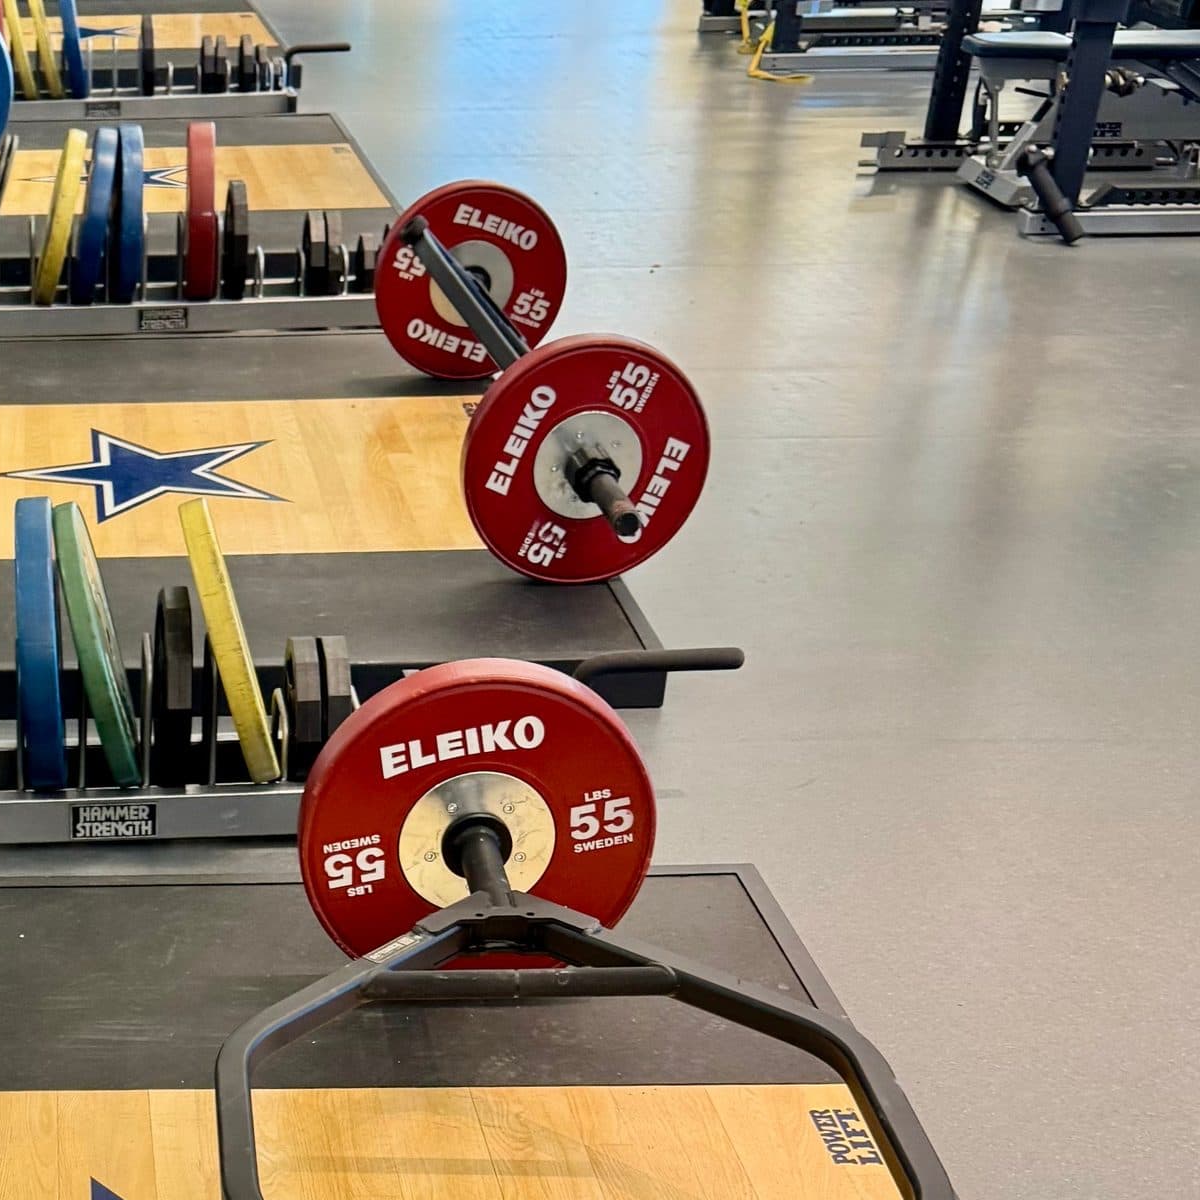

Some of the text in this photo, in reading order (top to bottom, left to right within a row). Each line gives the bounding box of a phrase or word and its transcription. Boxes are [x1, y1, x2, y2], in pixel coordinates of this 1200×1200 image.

[453, 203, 538, 251] ELEIKO
[392, 247, 426, 277] 55
[512, 292, 551, 322] 55
[406, 318, 488, 363] ELEIKO
[605, 370, 621, 390] LBS
[609, 361, 651, 410] 55
[633, 372, 660, 413] SWEDEN
[484, 385, 557, 496] ELEIKO
[527, 521, 566, 567] 55
[379, 715, 545, 780] ELEIKO
[78, 806, 150, 823] HAMMER
[584, 788, 612, 802] LBS
[76, 820, 152, 837] STRENGTH
[569, 796, 635, 840] 55
[323, 834, 381, 854] SWEDEN
[573, 832, 634, 853] SWEDEN
[323, 847, 385, 890] 55
[347, 883, 373, 897] LBS
[809, 1108, 858, 1165] POWER
[832, 1108, 883, 1165] LIFT
